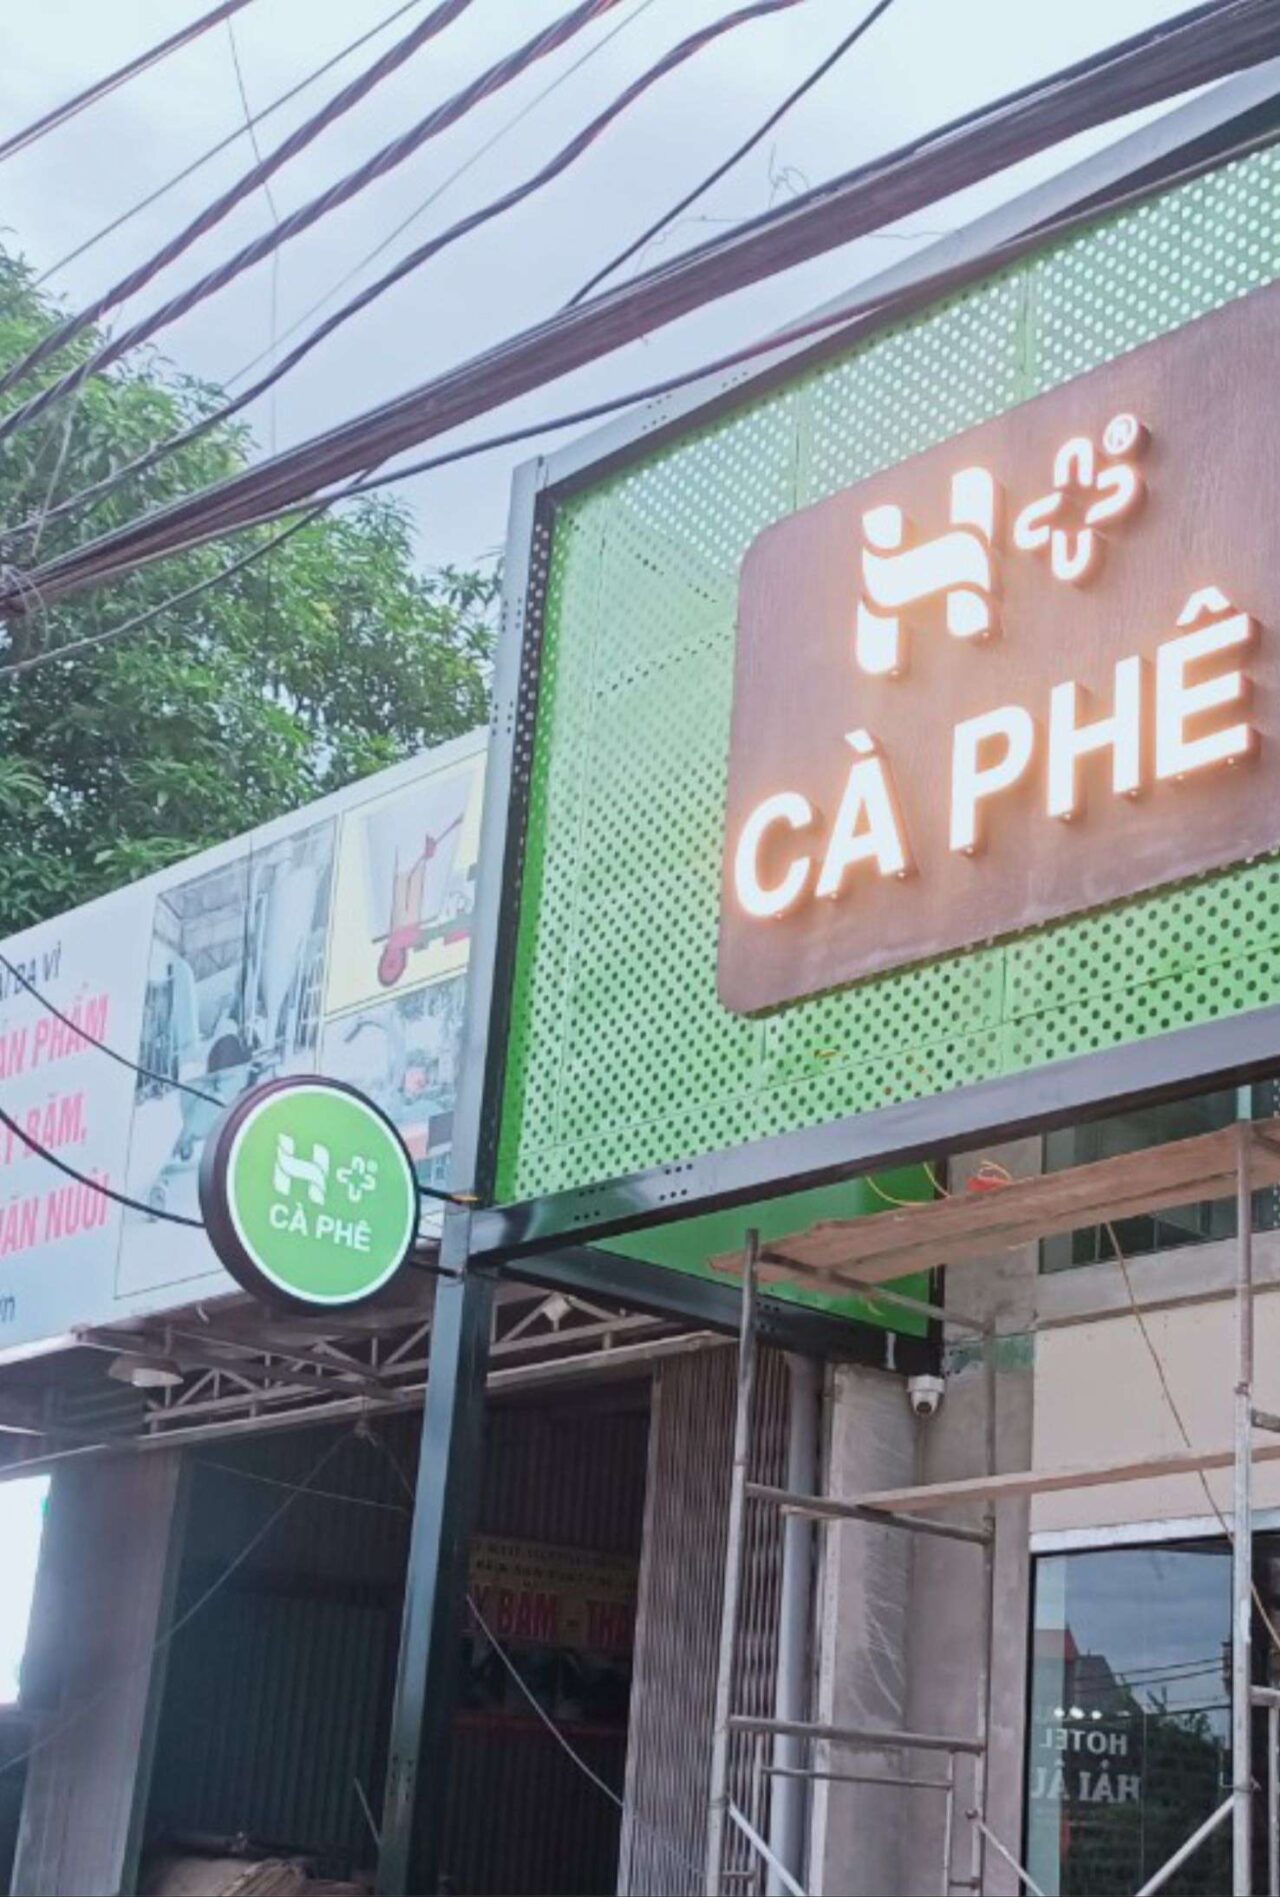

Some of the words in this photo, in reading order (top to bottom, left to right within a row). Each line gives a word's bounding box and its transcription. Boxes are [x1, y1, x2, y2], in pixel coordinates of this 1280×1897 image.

[733, 729, 908, 918] CÀ
[949, 586, 1251, 852] PHÊ
[269, 1201, 308, 1236] CÀ
[315, 1214, 372, 1252] PHÊ
